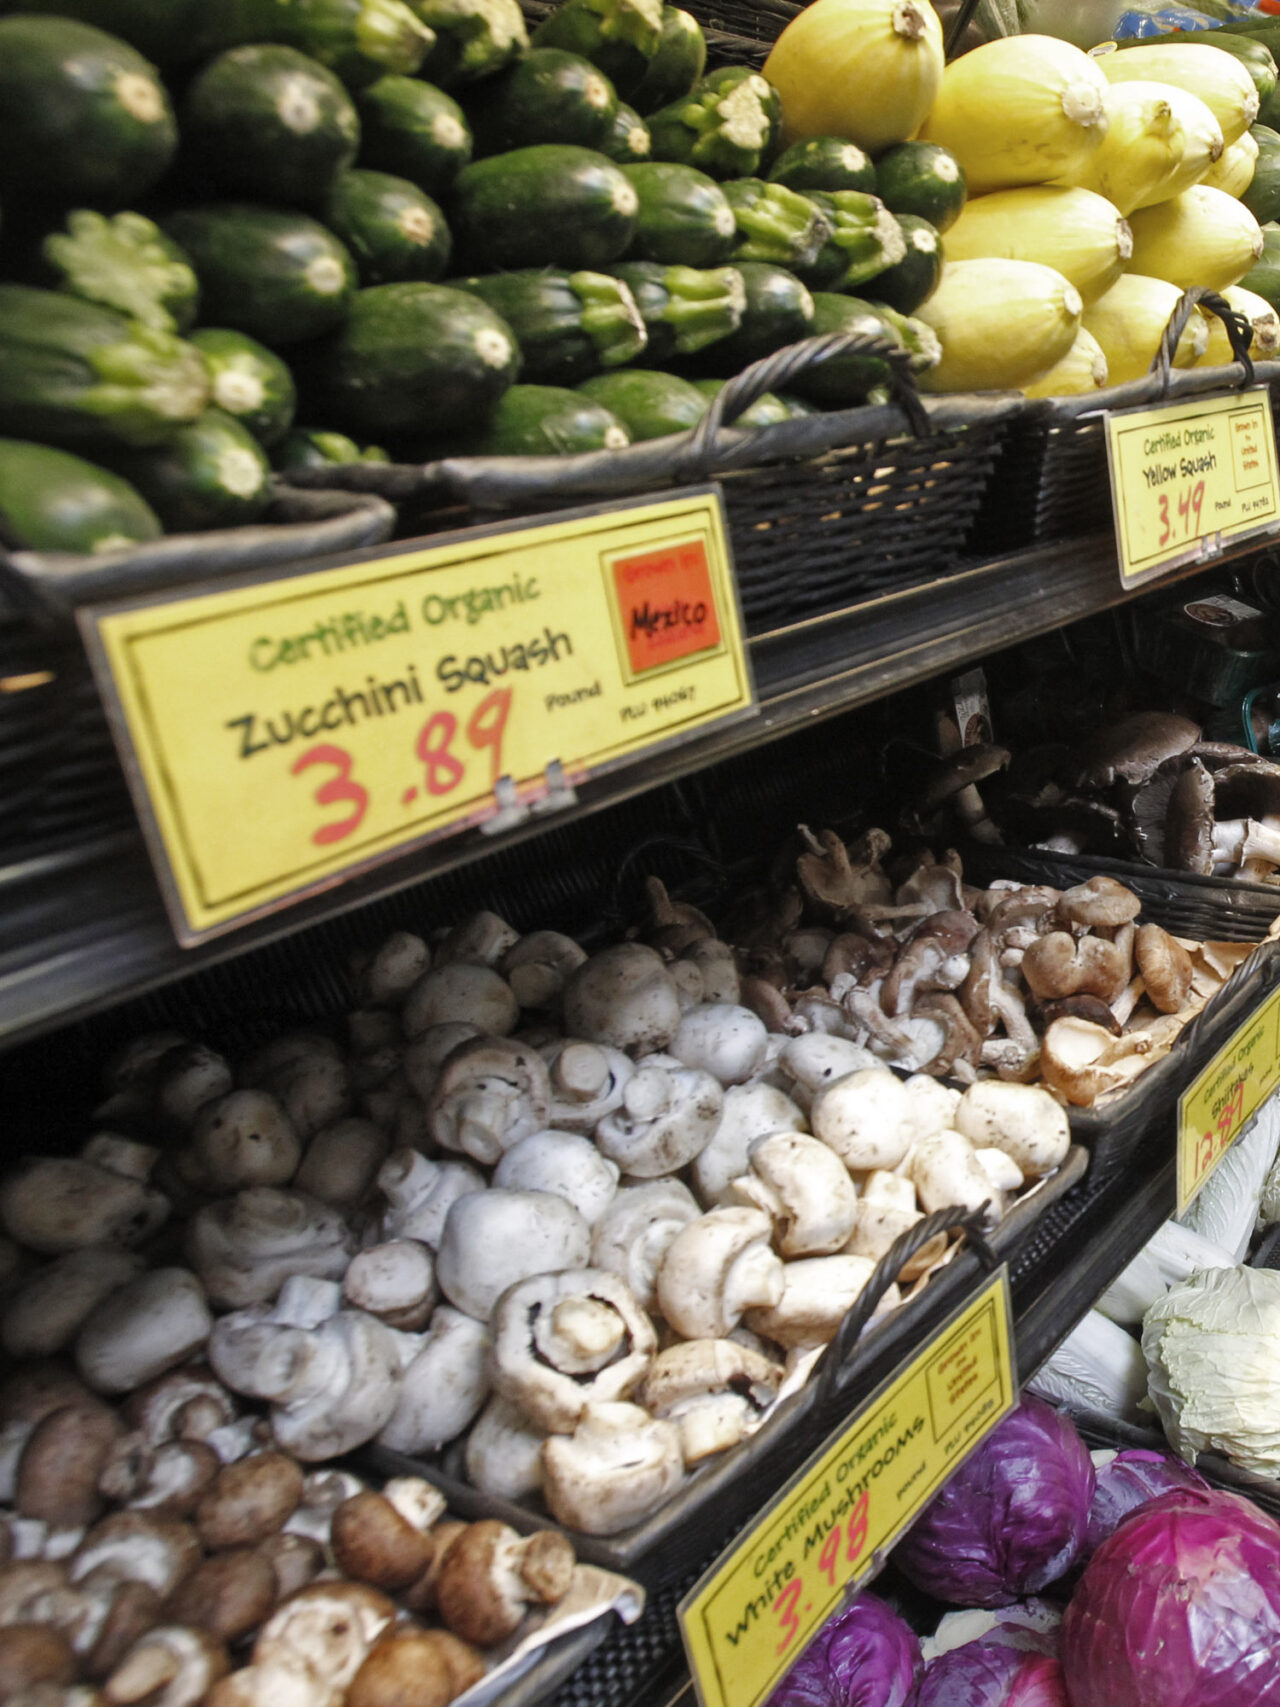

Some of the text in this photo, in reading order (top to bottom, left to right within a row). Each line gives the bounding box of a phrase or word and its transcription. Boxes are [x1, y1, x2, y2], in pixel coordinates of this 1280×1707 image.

[1142, 451, 1217, 489] Yellow Squash
[1144, 424, 1215, 457] Certified Organic
[1158, 480, 1205, 547] 3.49
[248, 573, 541, 674] Certified Organic
[630, 600, 708, 642] Mexico
[225, 628, 576, 759] Zucchini Squash
[290, 684, 515, 846] 3.89
[1203, 1024, 1265, 1105] Certified Organic
[1194, 1081, 1245, 1181] 12.89
[726, 1415, 926, 1648] White Mushrooms
[753, 1411, 899, 1578] Certified Organic
[772, 1489, 870, 1657] 3.98
